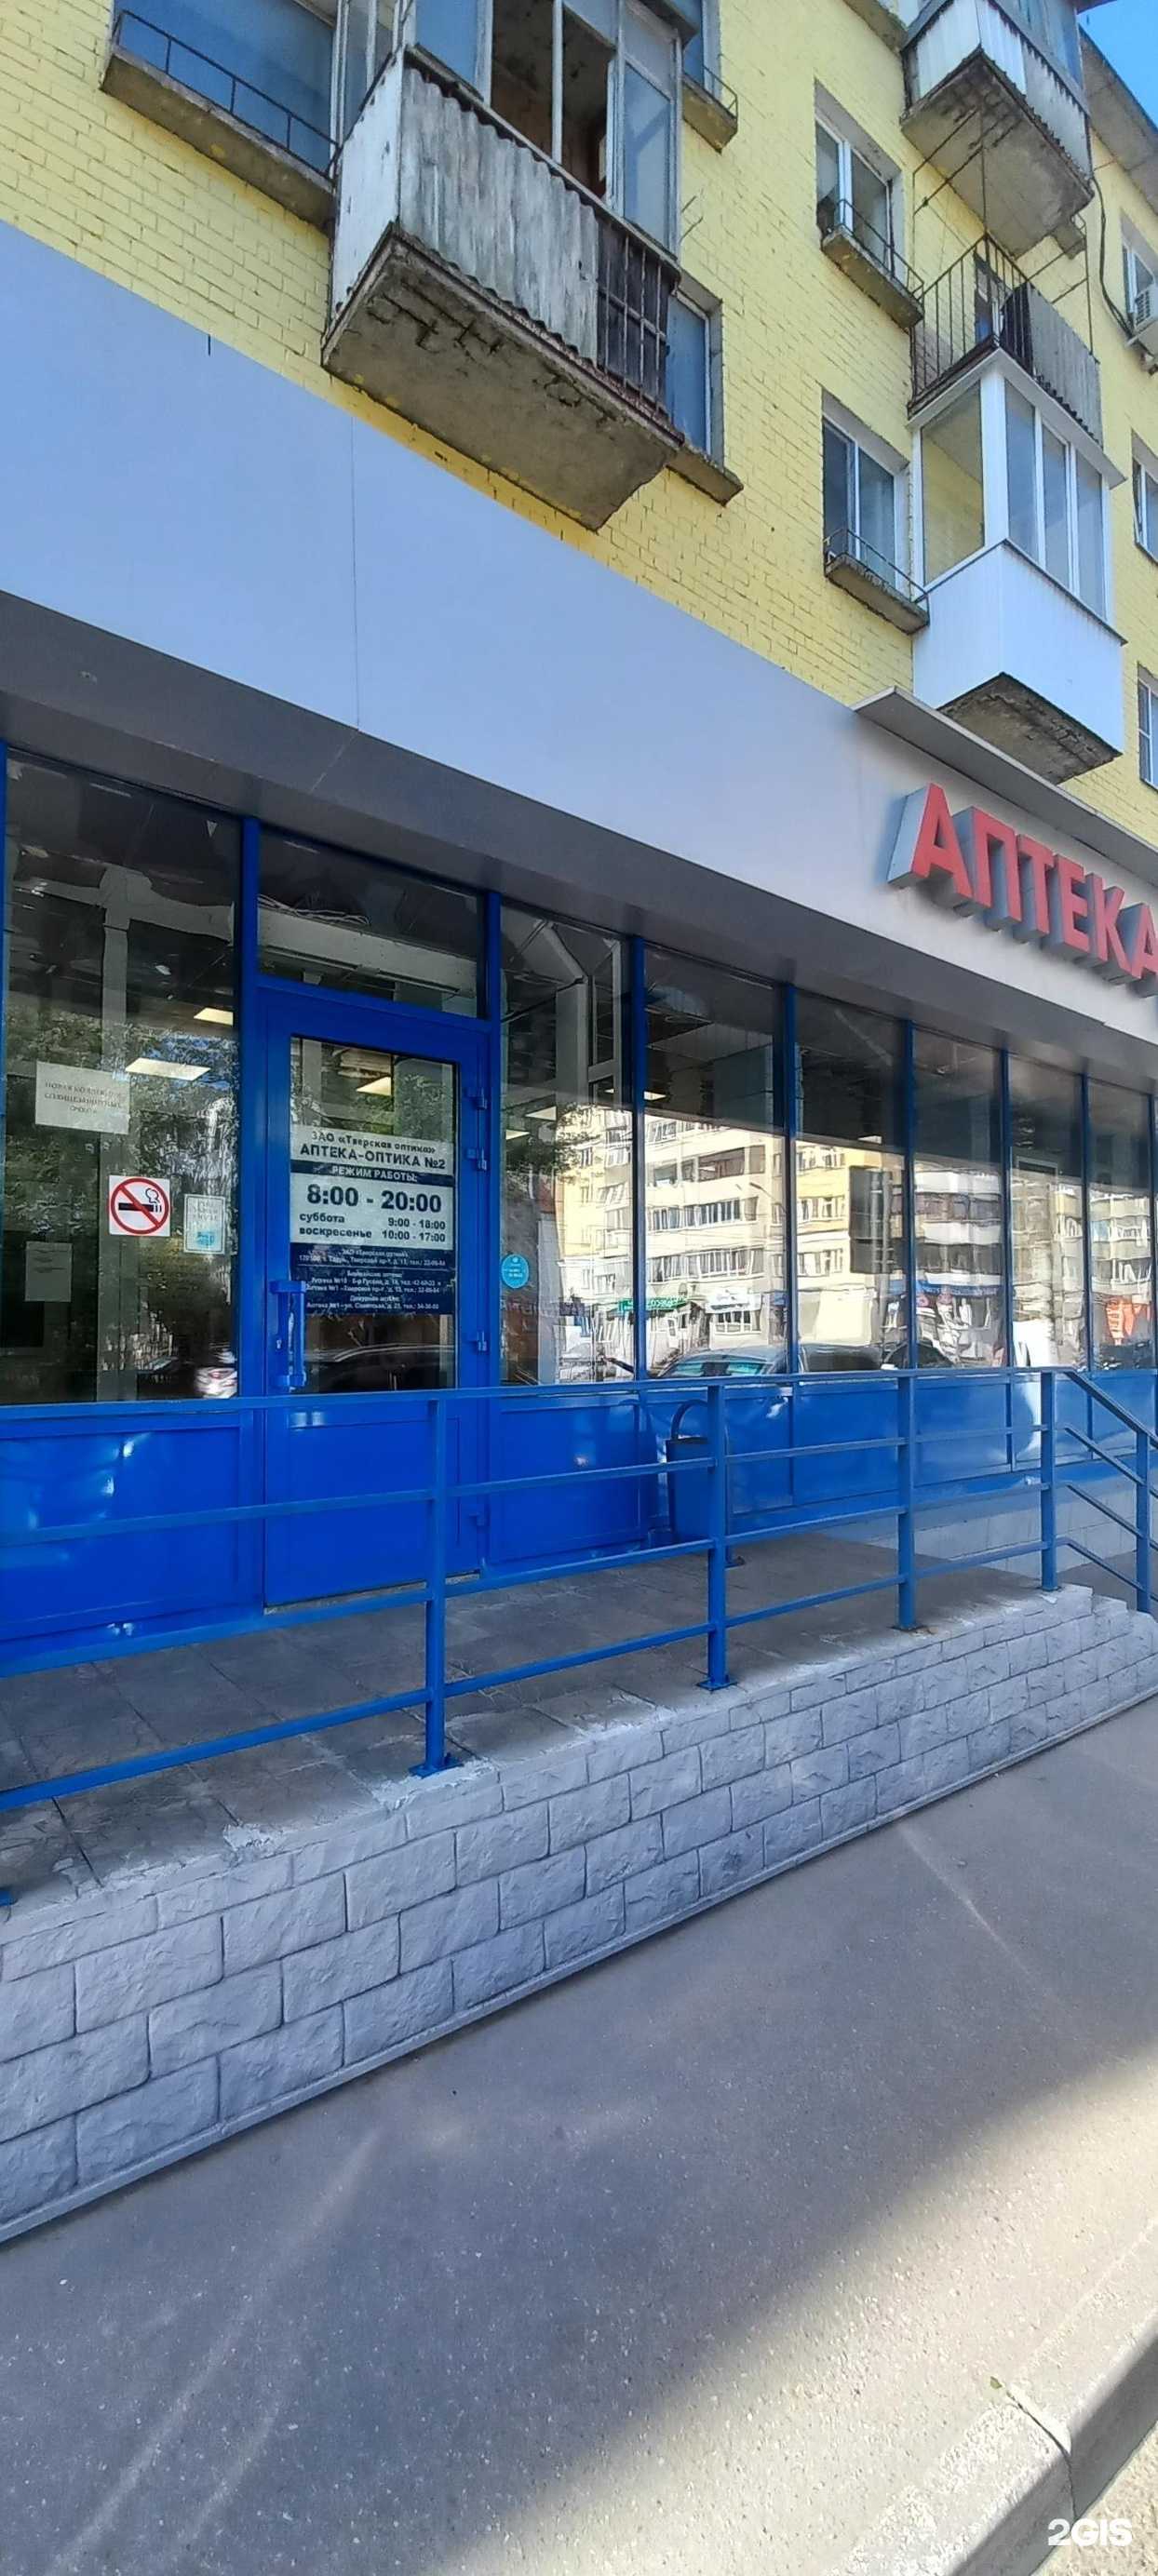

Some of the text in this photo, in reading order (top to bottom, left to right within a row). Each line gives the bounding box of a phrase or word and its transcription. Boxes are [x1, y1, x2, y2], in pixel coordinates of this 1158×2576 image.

[910, 783, 1158, 979] АПТЕКА
[312, 1131, 435, 1154] ЗАО «Тверская оптика»
[300, 1143, 445, 1169] АПТЕКА-ОПТИКА №2
[331, 1165, 418, 1182] РЕЖИМ РАБОТЫ:
[306, 1183, 359, 1207] 8:00
[381, 1190, 442, 1213] 20:00
[299, 1212, 345, 1224] суббота
[387, 1217, 411, 1228] 9:00
[419, 1219, 446, 1230] 18:00
[299, 1227, 372, 1239] воскресенье
[382, 1229, 411, 1241] 10:00
[419, 1231, 446, 1242] 17:00
